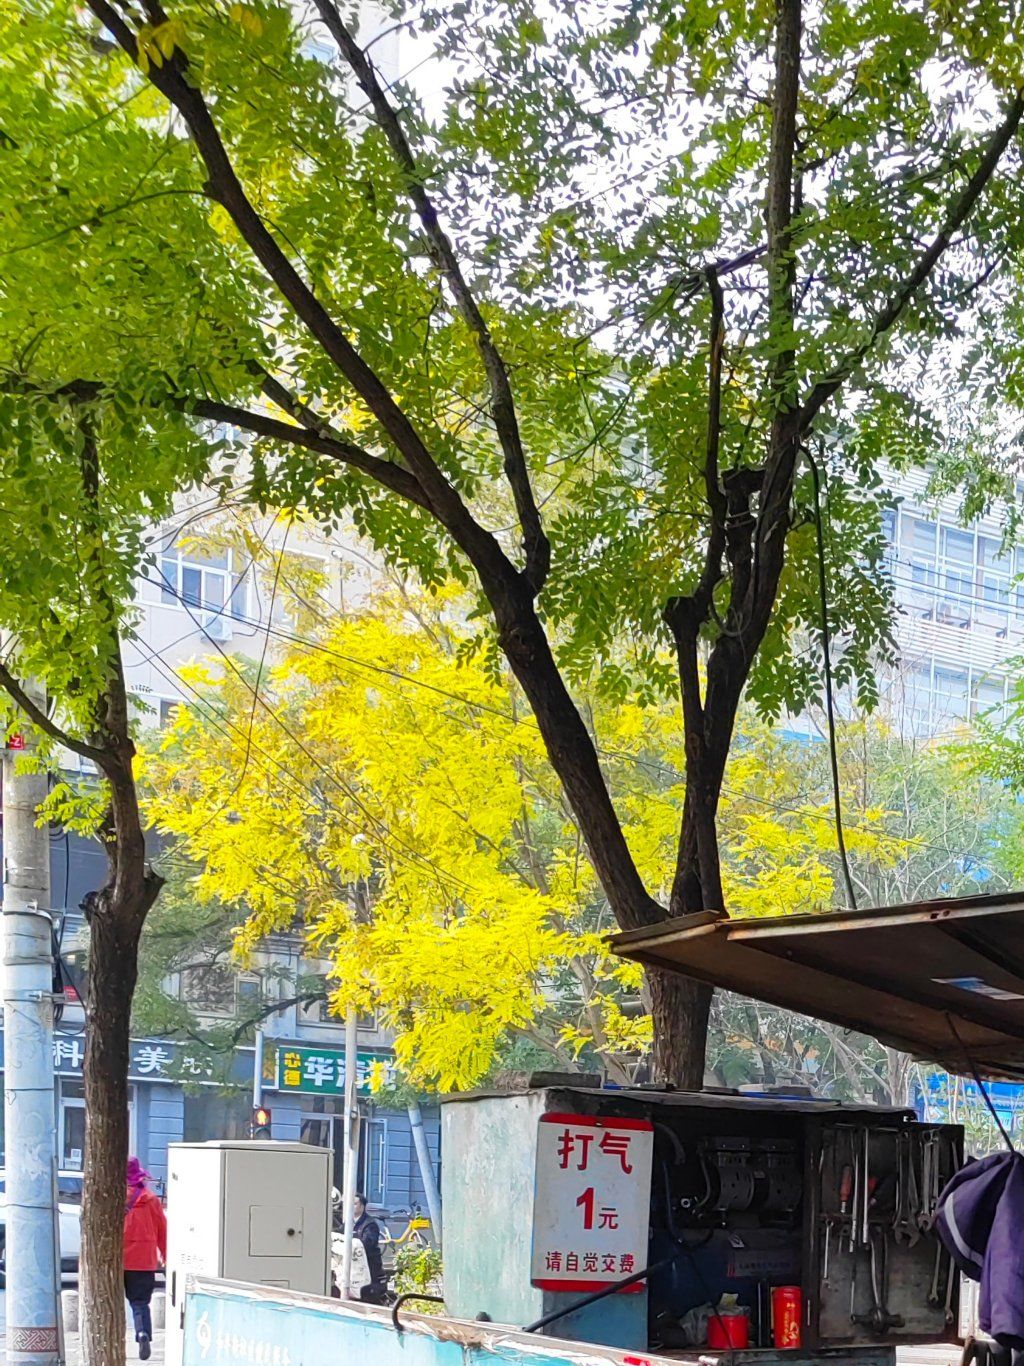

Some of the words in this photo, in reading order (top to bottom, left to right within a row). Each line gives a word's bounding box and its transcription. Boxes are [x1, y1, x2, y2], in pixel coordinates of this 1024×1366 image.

[558, 1129, 633, 1174] 打气
[545, 1251, 635, 1274] 请自觉交费
